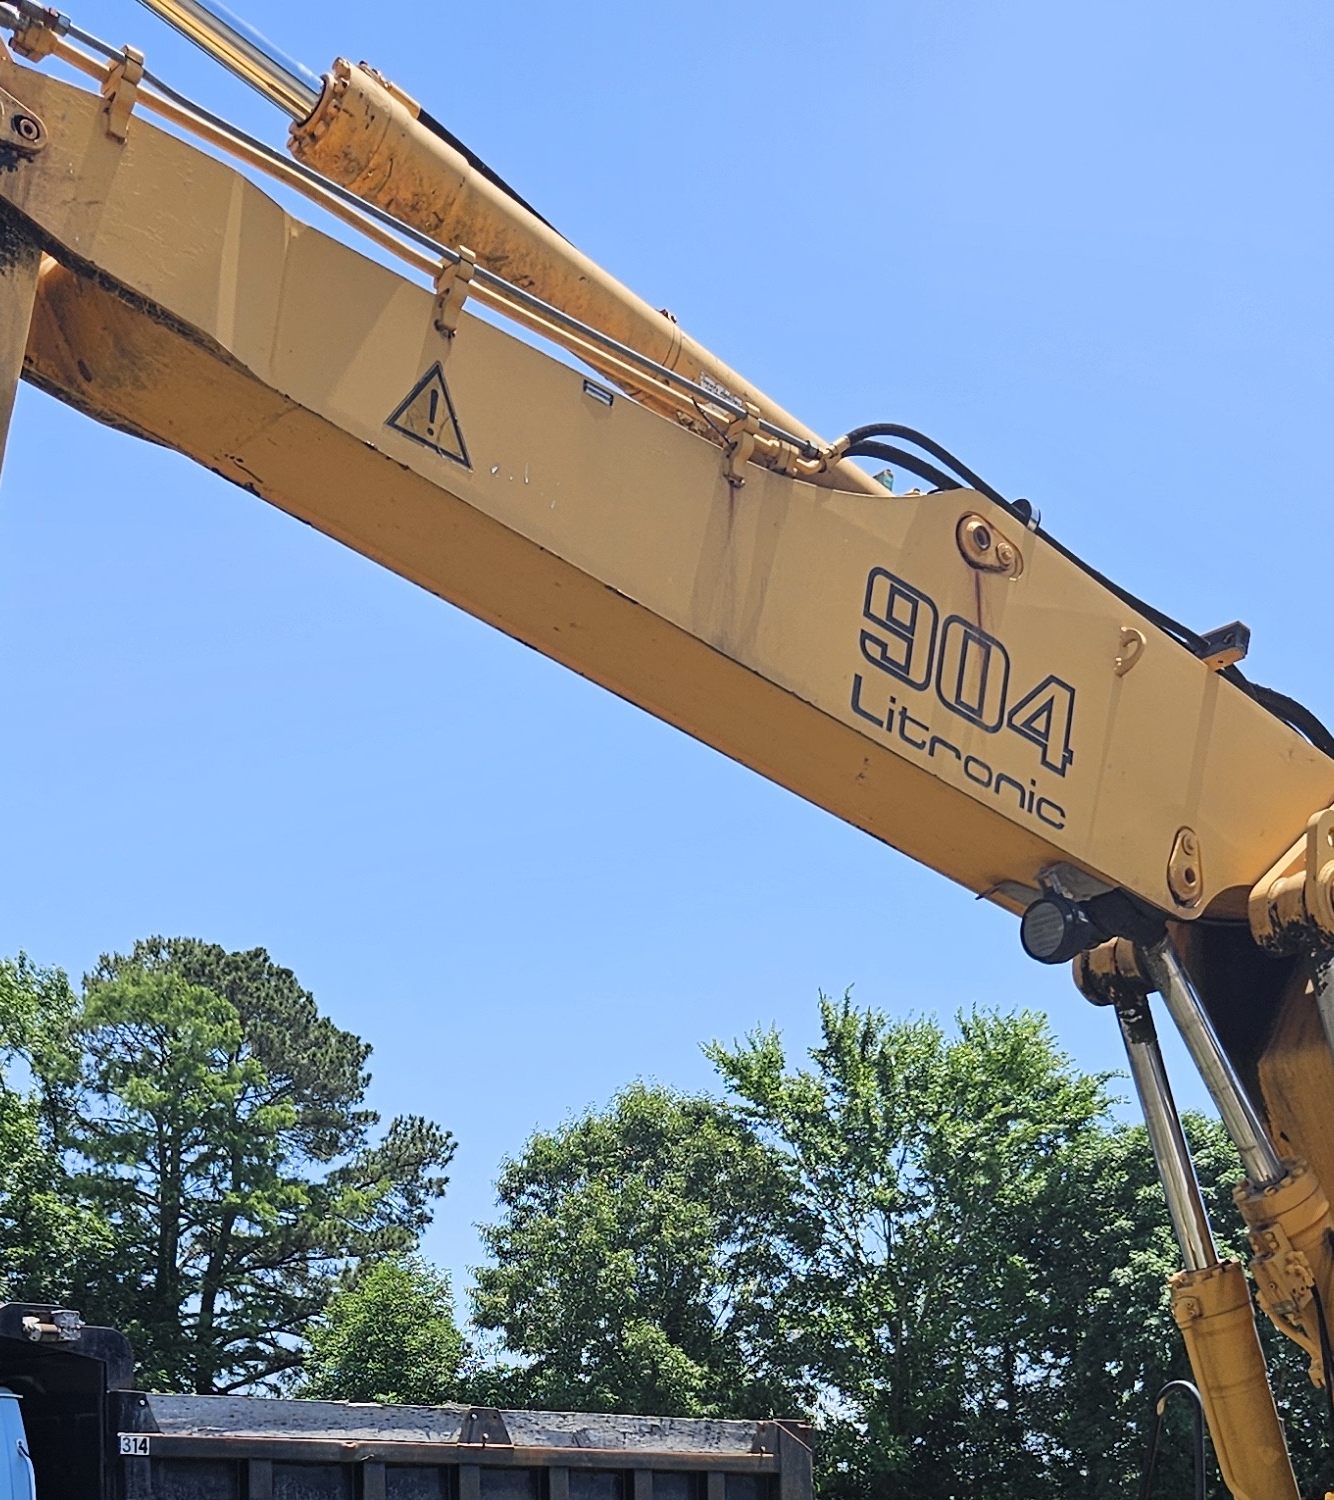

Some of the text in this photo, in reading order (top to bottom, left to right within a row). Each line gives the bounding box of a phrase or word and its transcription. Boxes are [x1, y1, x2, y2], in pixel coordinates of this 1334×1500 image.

[851, 672, 1066, 830] Litronic
[859, 566, 1075, 778] 904
[122, 1437, 148, 1454] 314
